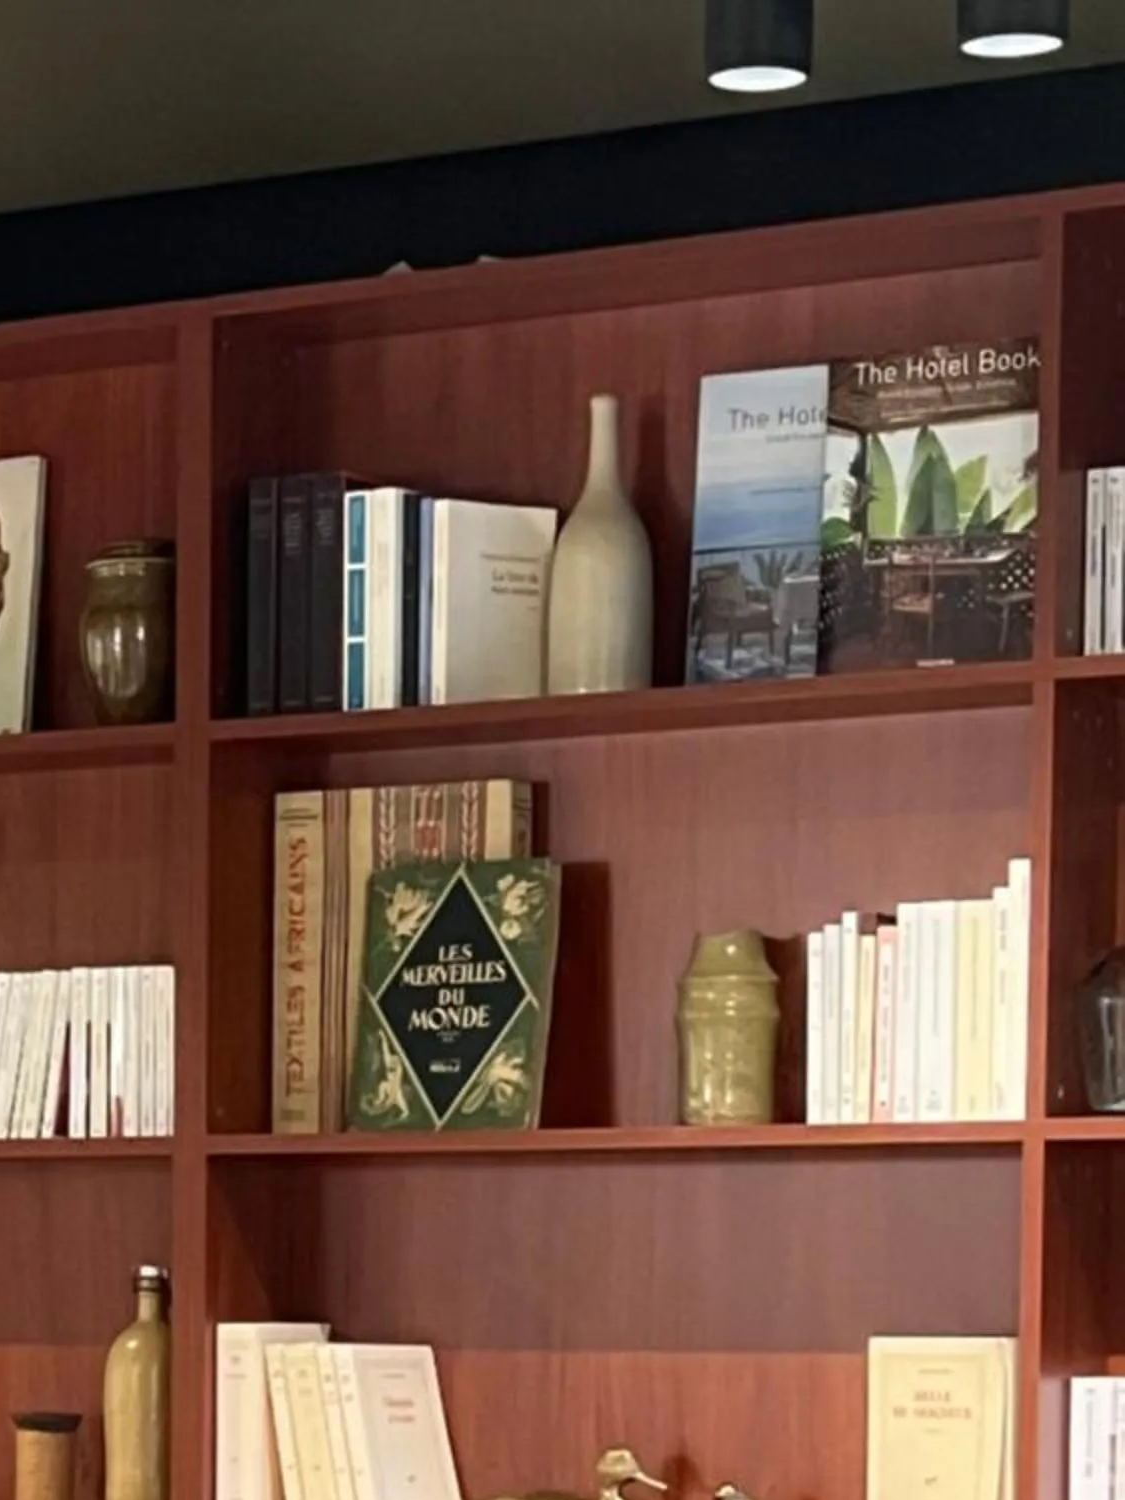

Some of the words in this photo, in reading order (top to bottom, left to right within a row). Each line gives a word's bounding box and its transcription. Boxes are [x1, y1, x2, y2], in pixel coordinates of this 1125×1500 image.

[855, 362, 897, 386] The
[906, 352, 969, 379] Hotel
[978, 347, 1042, 372] Book
[728, 407, 770, 432] The
[286, 836, 309, 973] AFRICAINS
[438, 943, 473, 962] LES
[400, 959, 507, 987] MERVEILLES
[438, 987, 466, 1006] DU
[407, 1003, 491, 1032] MONDE
[285, 985, 306, 1098] TEXTILES
